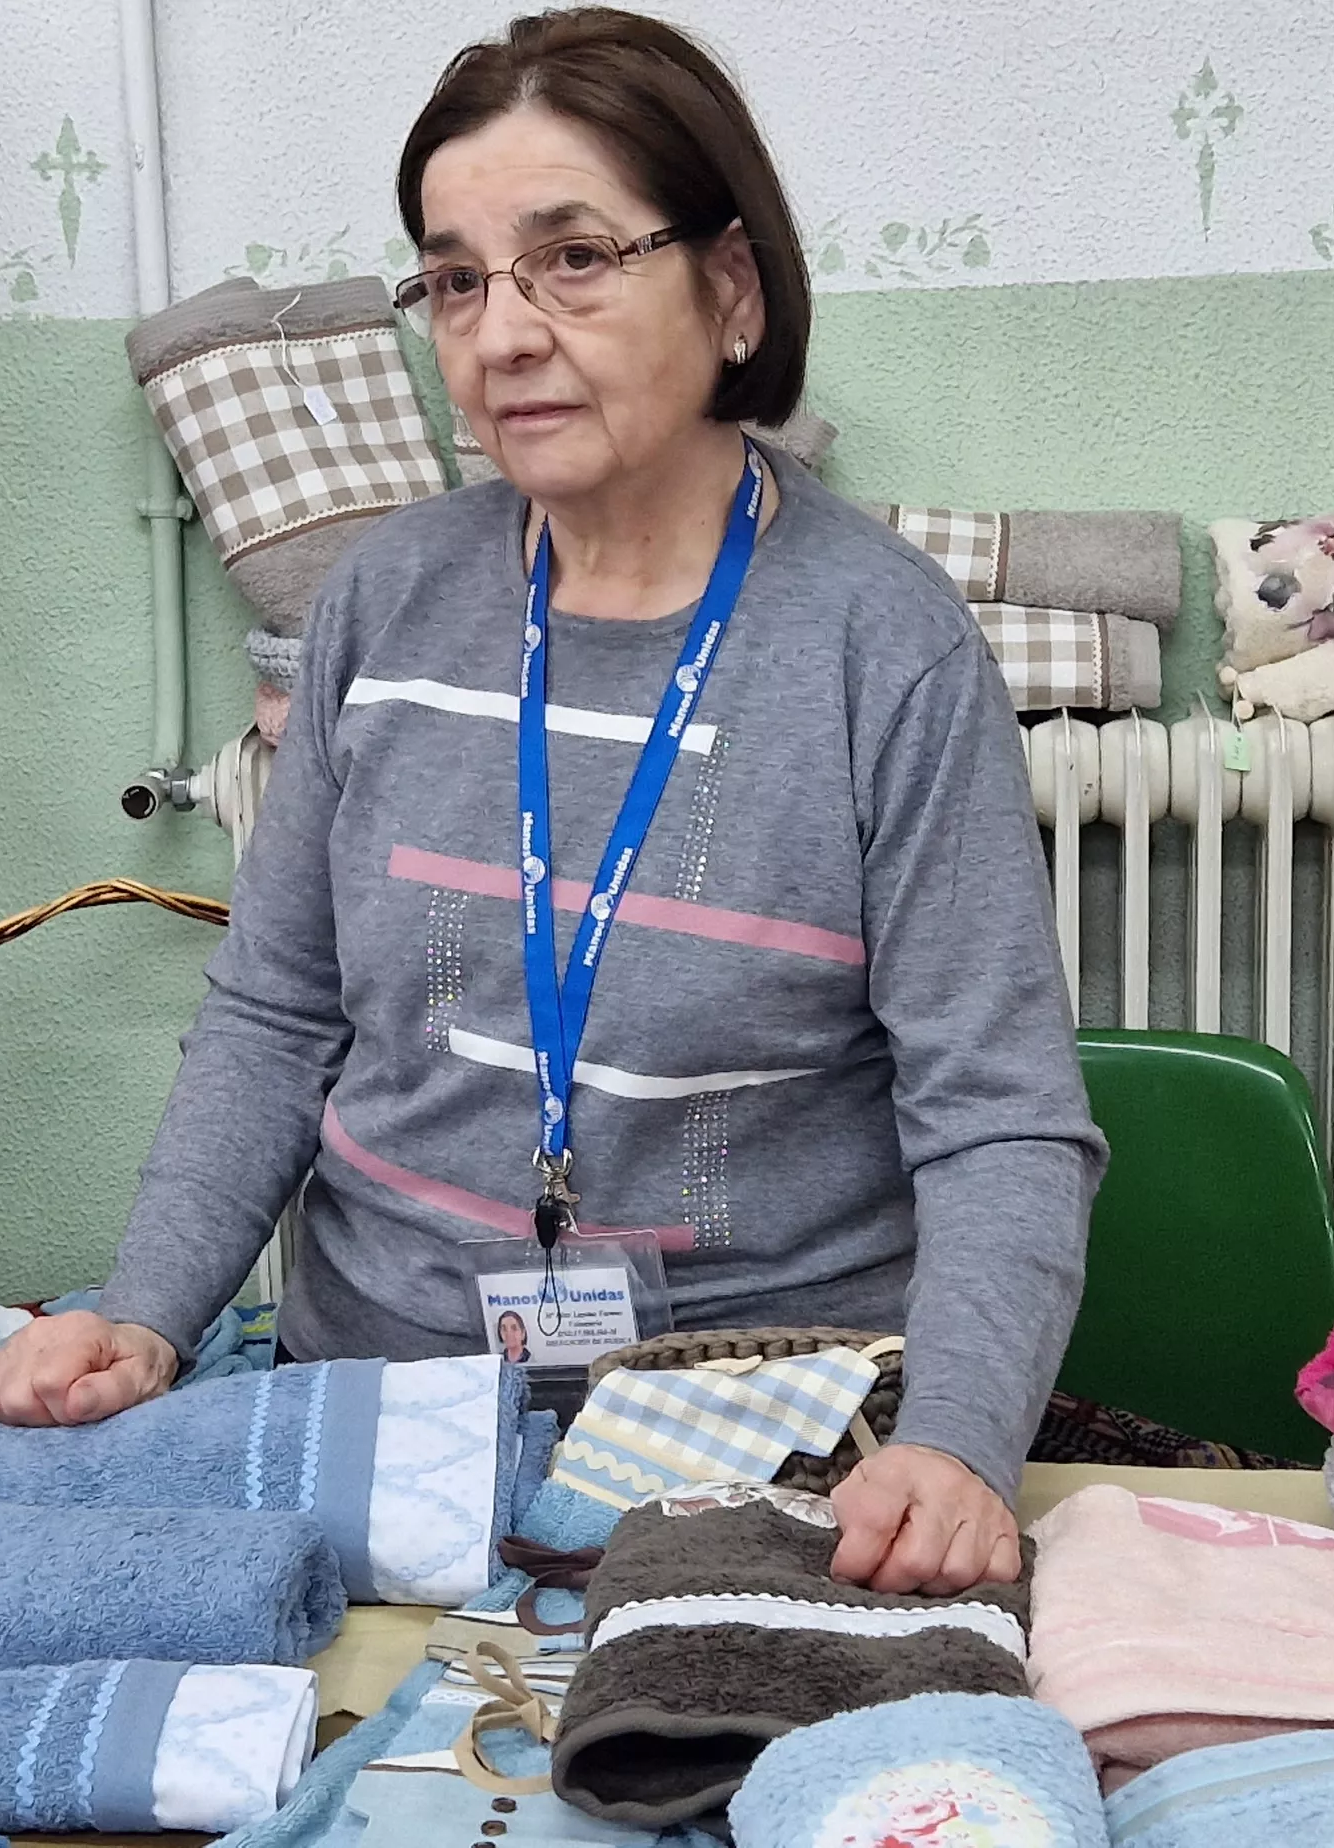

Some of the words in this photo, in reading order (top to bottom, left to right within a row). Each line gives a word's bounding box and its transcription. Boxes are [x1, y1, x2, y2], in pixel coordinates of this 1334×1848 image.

[668, 693, 693, 738] Manos
[694, 620, 722, 669] Unidas
[522, 811, 534, 858] Manos
[524, 884, 537, 935] Unidas
[583, 921, 605, 968] Manos
[607, 847, 634, 896] Unidas
[487, 1294, 539, 1307] Manos
[570, 1288, 625, 1302] Unidas
